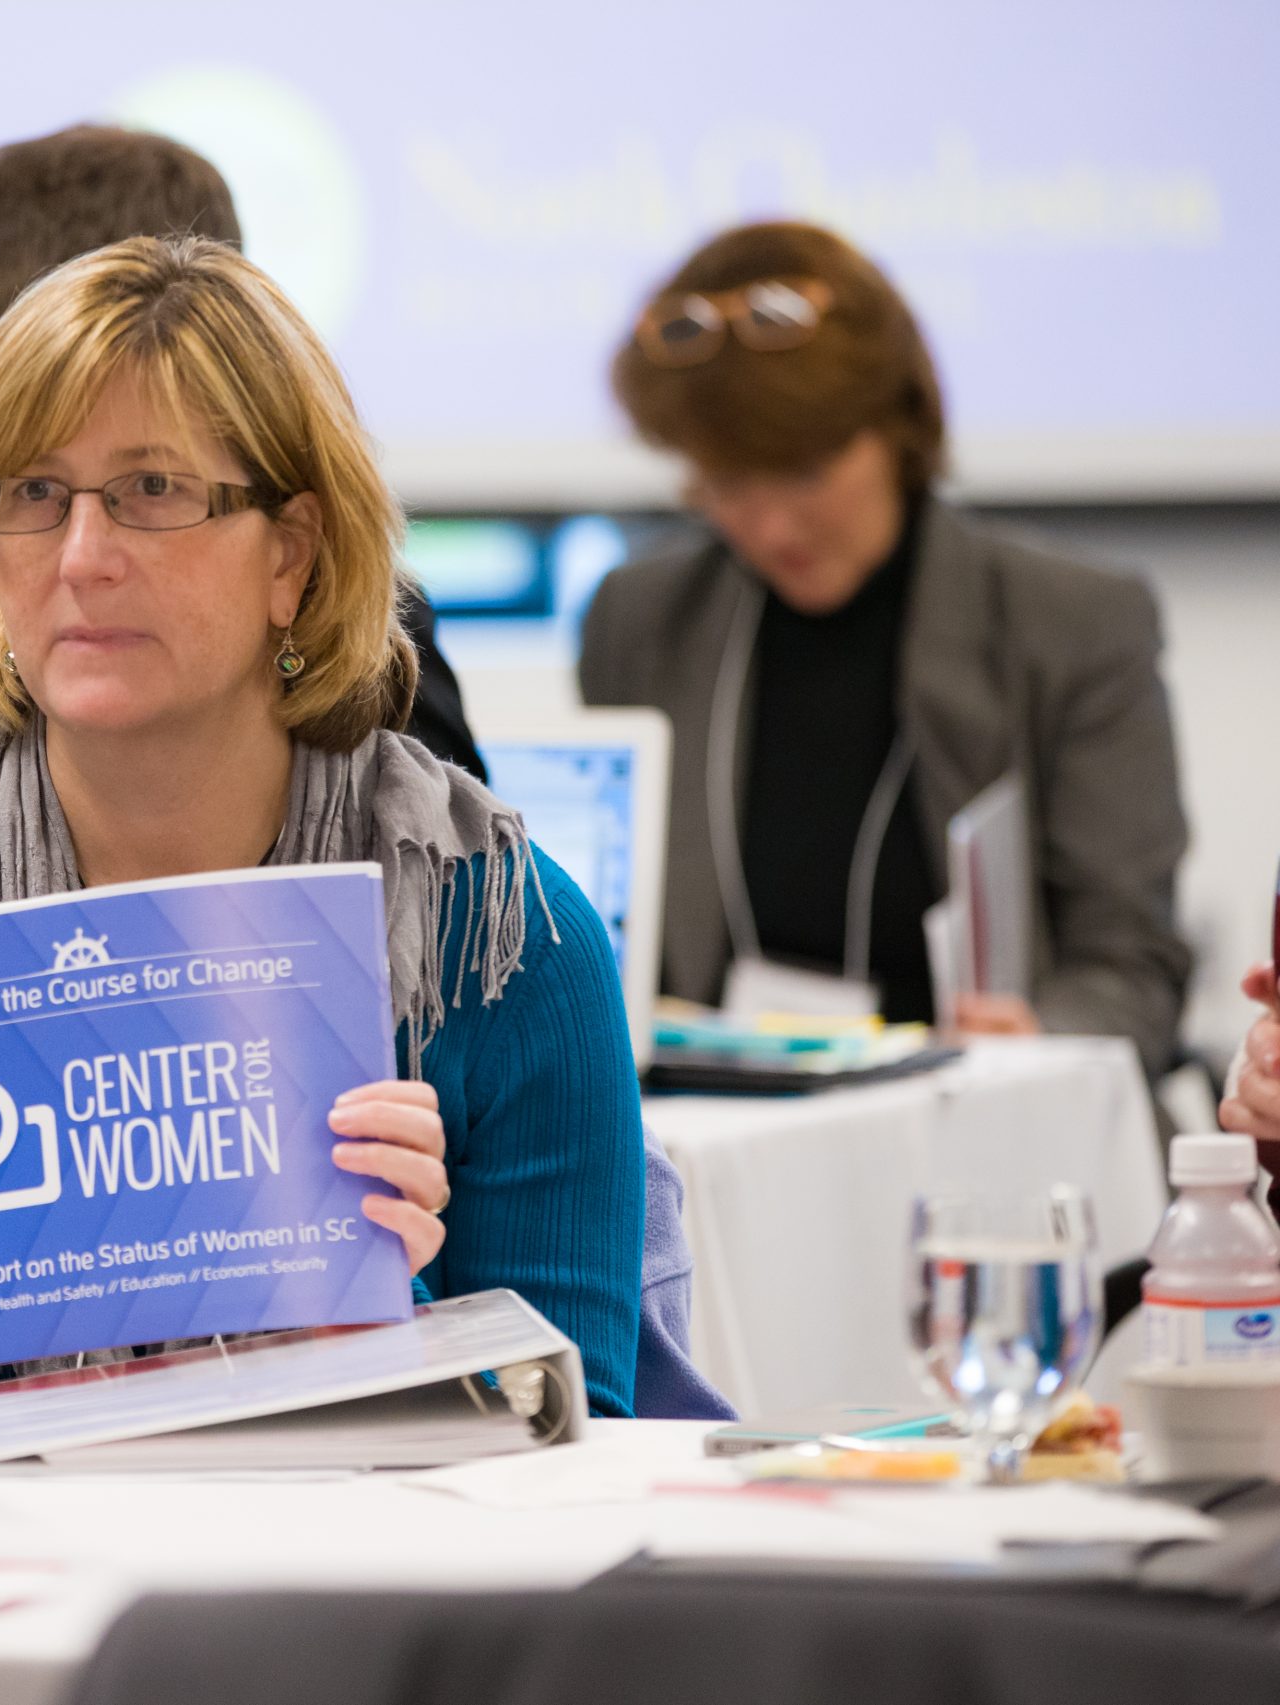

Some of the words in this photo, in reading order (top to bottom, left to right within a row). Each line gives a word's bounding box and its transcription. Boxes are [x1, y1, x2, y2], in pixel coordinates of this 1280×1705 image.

[1, 985, 42, 1013] the
[47, 973, 137, 1005] Course
[142, 963, 181, 991] for
[186, 956, 293, 986] Change
[63, 1040, 240, 1123] CENTER
[242, 1037, 275, 1100] FOR
[68, 1103, 280, 1198] WOMEN
[25, 1257, 55, 1279] on
[58, 1249, 95, 1274] the
[98, 1240, 169, 1268] Status
[173, 1231, 199, 1258] of
[201, 1226, 294, 1254] Women
[298, 1222, 320, 1244] in
[324, 1217, 358, 1242] SC
[36, 1289, 62, 1305] and
[62, 1283, 105, 1301] Safety
[121, 1271, 186, 1292] Education
[202, 1262, 269, 1282] Economic
[271, 1255, 328, 1275] Security
